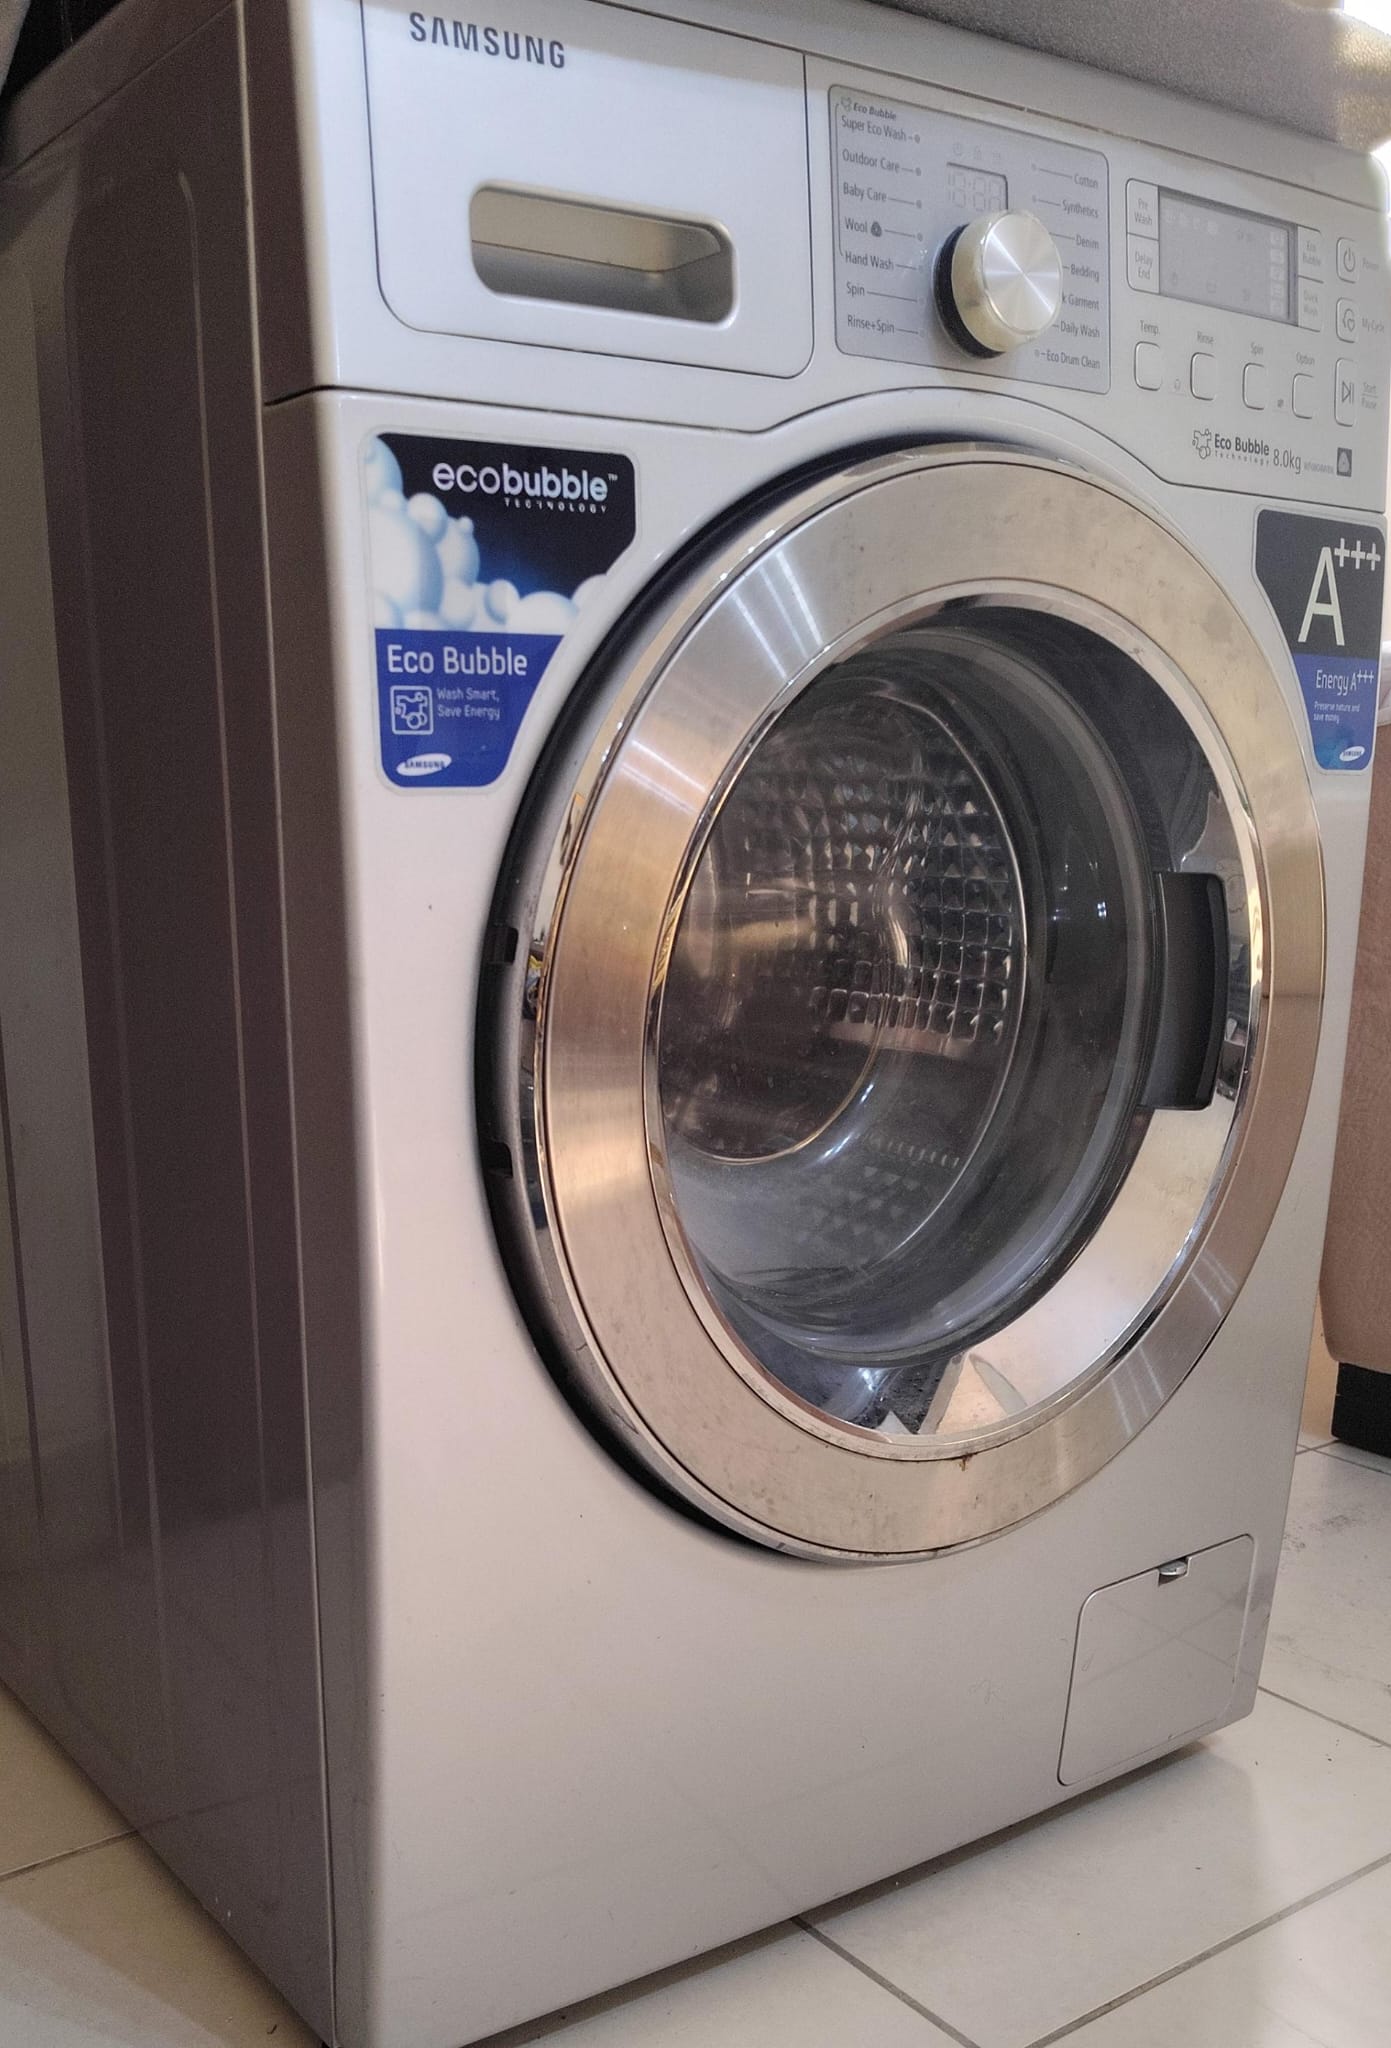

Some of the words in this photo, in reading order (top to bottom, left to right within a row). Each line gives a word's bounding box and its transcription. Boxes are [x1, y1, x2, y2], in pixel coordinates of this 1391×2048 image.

[409, 11, 566, 69] SAMSUNG
[853, 102, 868, 114] Eco
[869, 106, 897, 120] Bubble
[841, 114, 865, 133] Super
[867, 121, 882, 136] Eco
[883, 125, 907, 141] Wash
[842, 148, 878, 168] Outdoor
[880, 157, 900, 174] Care
[1073, 173, 1099, 189] Cotton
[843, 181, 865, 201] Baby
[866, 187, 887, 202] Care
[1062, 199, 1099, 219] Synthetics
[844, 216, 868, 234] Wool
[1134, 211, 1153, 226] Wash
[1076, 234, 1100, 250] Denim
[845, 250, 868, 267] Hand
[869, 255, 894, 271] Wash
[1134, 251, 1154, 267] Delay
[1070, 263, 1100, 284] Bedding
[1137, 267, 1151, 281] End
[846, 281, 866, 298] Spin
[1067, 293, 1100, 311] Garment
[847, 314, 895, 335] Rinse+Spin
[1060, 320, 1080, 337] Daily
[1080, 324, 1100, 339] Wash
[1196, 331, 1215, 345] Rinse
[1250, 342, 1264, 355] Spin
[1046, 349, 1060, 363] Eco
[1060, 351, 1080, 366] Drum
[1081, 355, 1101, 370] Clean
[1295, 352, 1316, 366] Option
[1214, 433, 1232, 450] Eco
[1234, 437, 1270, 456] Bubble
[1273, 449, 1302, 475] 8.0kg
[387, 643, 435, 675] Eco
[442, 645, 528, 676] Bubble
[1315, 669, 1350, 696] Energy
[436, 687, 464, 701] Wash
[465, 687, 500, 703] Smart,
[437, 704, 462, 719] Save
[463, 704, 501, 721] Energy
[403, 760, 446, 769] SAMSUNG
